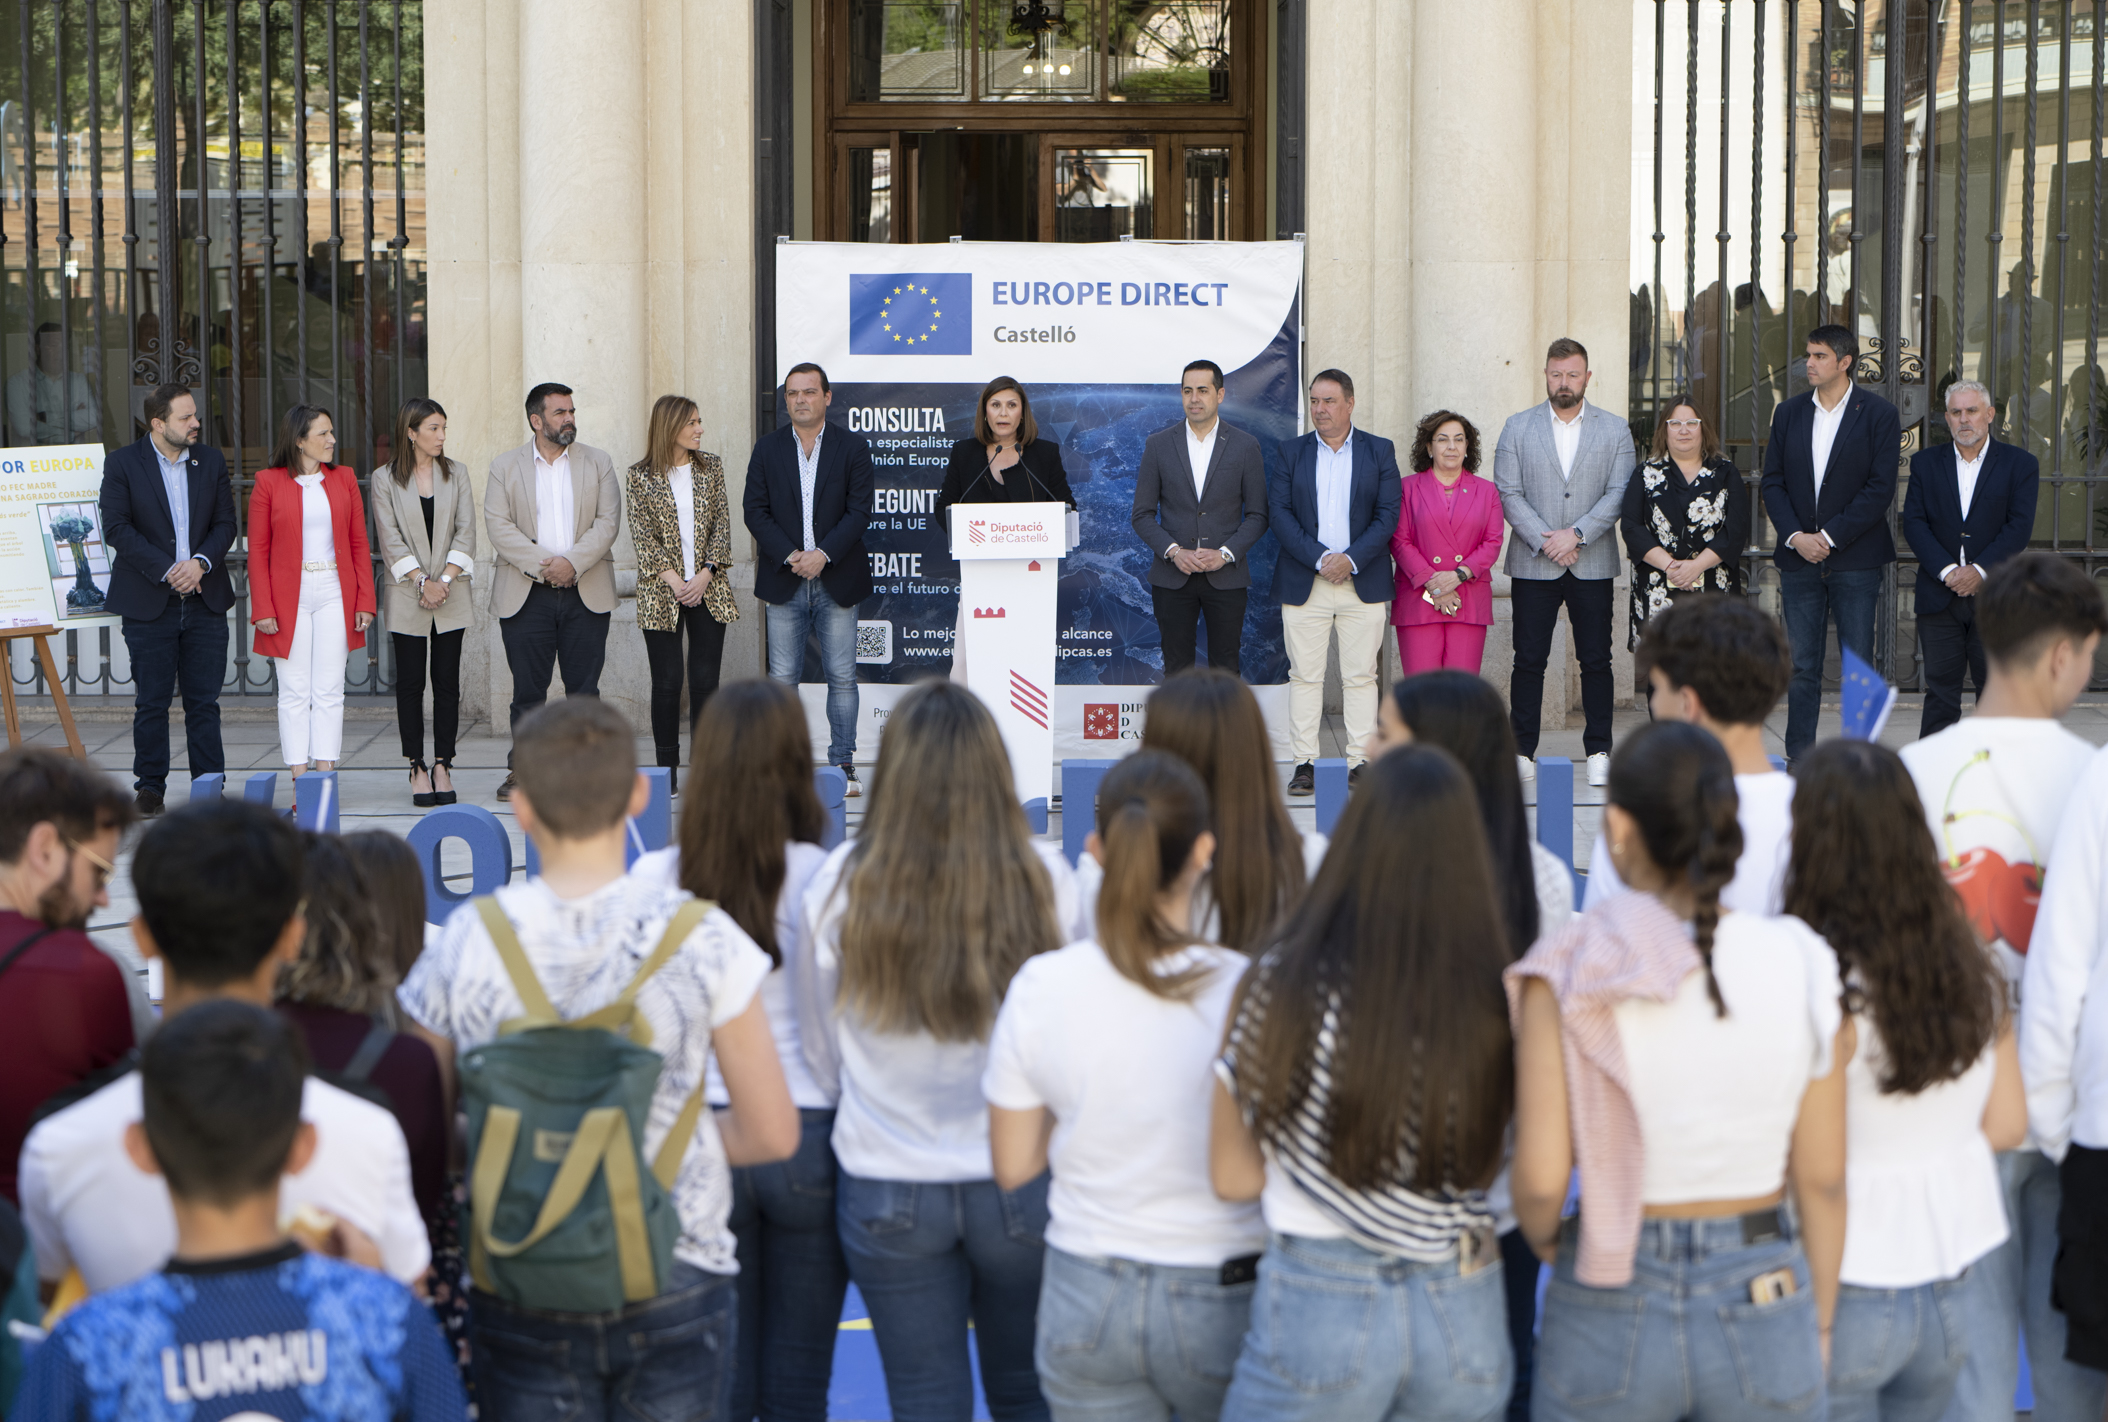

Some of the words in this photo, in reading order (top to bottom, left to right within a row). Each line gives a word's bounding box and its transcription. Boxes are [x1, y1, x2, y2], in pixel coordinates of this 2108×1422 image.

[993, 282, 1112, 305] EUROPE
[1121, 282, 1228, 306] DIRECT
[993, 325, 1076, 343] Castelló
[848, 407, 945, 432] CONSULTA
[876, 436, 960, 452] especialista
[0, 460, 25, 474] OR
[30, 457, 95, 473] EUROPA
[9, 483, 25, 491] FEC
[27, 482, 57, 490] MADRE
[15, 492, 56, 501] SAGRADO
[58, 489, 99, 499] CORAZÓN
[871, 489, 942, 514] EGUNT
[891, 517, 903, 530] la
[907, 518, 927, 530] UE
[990, 521, 1043, 534] Diputació
[990, 534, 1004, 543] de
[1006, 532, 1049, 543] Castelló
[891, 582, 903, 594] el
[907, 582, 949, 594] futuro
[903, 627, 919, 639] Lo
[1061, 626, 1113, 639] alcance
[873, 707, 892, 718] Pro
[162, 1328, 328, 1405] LUKAKU
